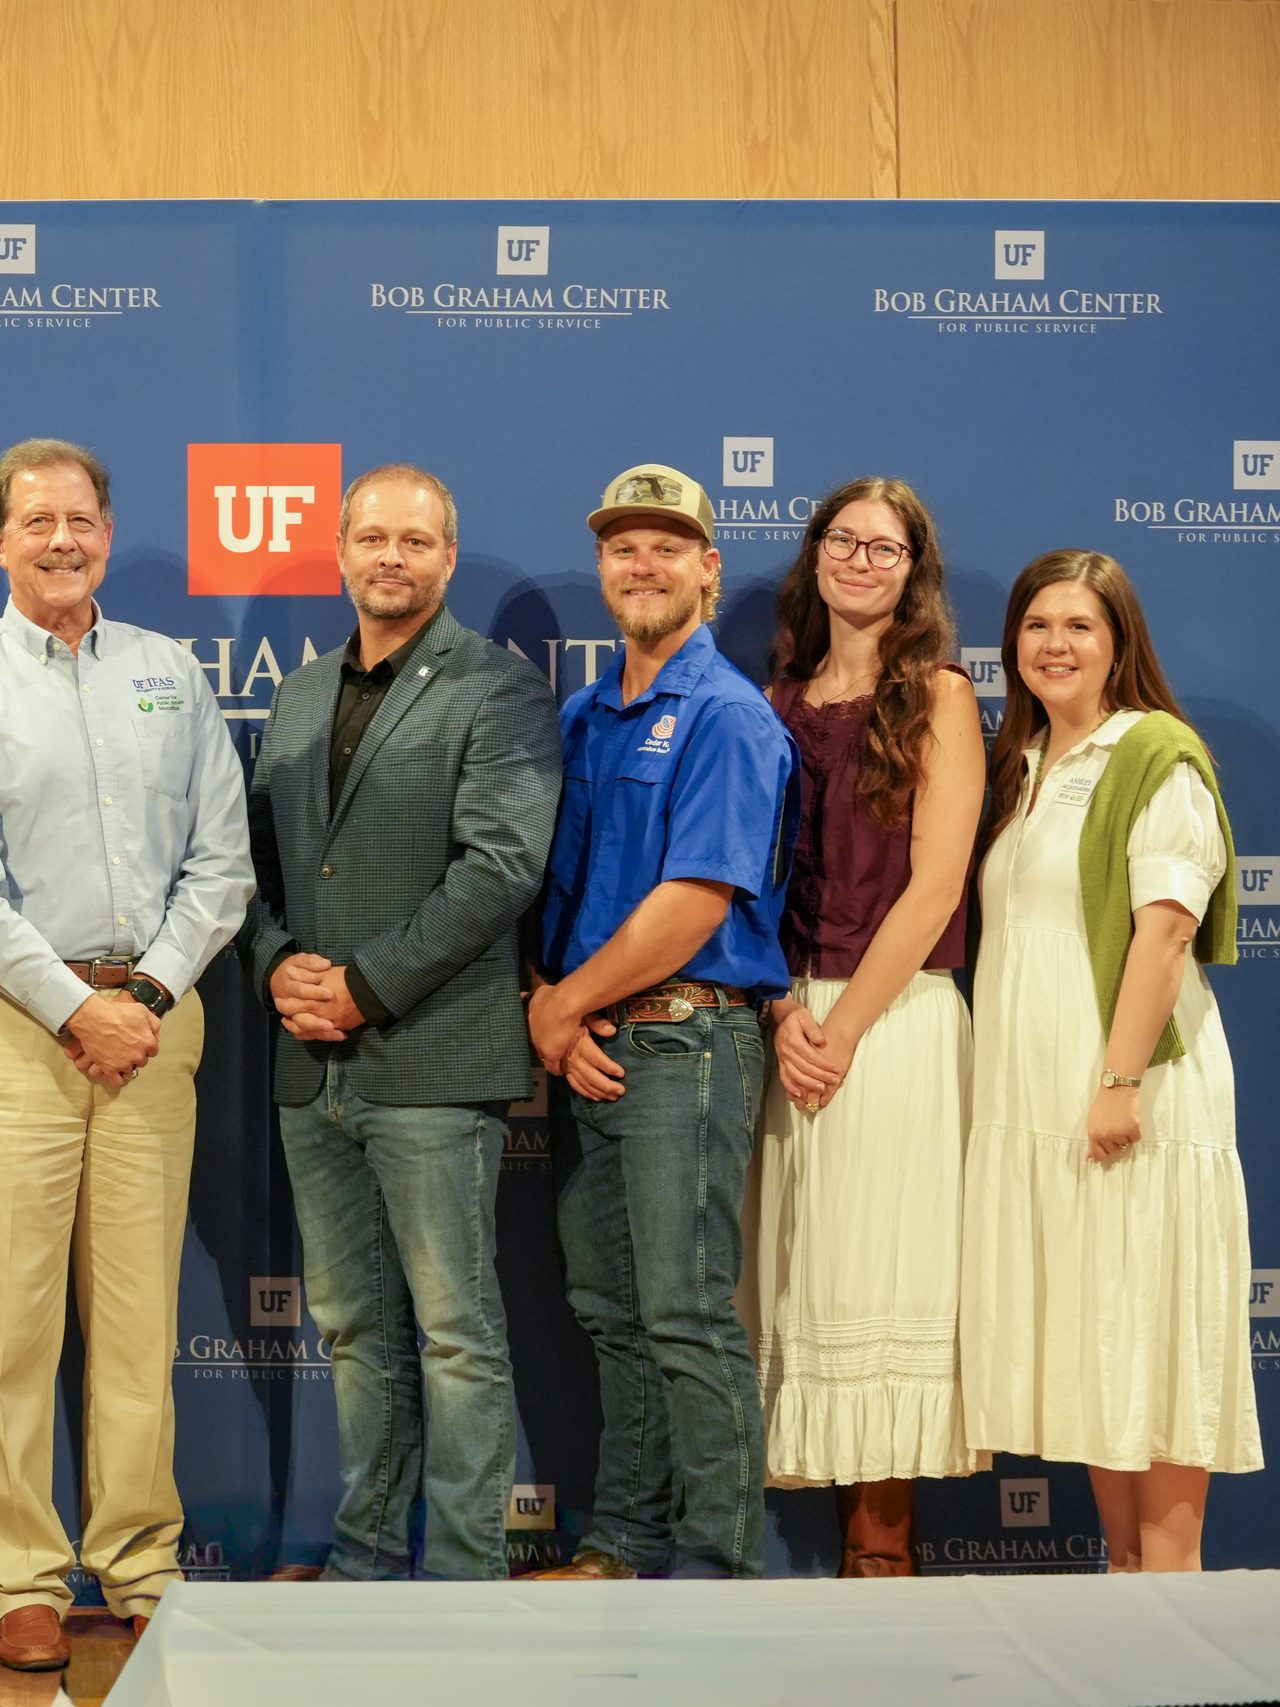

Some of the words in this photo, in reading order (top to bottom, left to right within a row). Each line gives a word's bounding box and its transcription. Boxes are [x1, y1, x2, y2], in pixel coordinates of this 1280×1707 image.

[507, 239, 540, 262] UF
[1003, 244, 1036, 266] UF
[51, 284, 161, 309] CENTER
[371, 283, 425, 308] BOB
[433, 283, 555, 309] GRAHAM
[562, 284, 670, 310] CENTER
[873, 288, 926, 313] BOB
[934, 288, 1051, 313] GRAHAM
[1059, 289, 1164, 314] CENTER
[27, 318, 92, 328] SERVICE
[438, 317, 468, 328] FOR
[475, 318, 532, 329] PUBLIC
[538, 318, 602, 329] SERVICE
[938, 322, 968, 333] FOR
[975, 322, 1029, 334] PUBLIC
[1035, 322, 1097, 334] SERVICE
[732, 451, 765, 473] UF
[1242, 454, 1274, 477] UF
[214, 485, 315, 553] UF
[1114, 498, 1166, 523] BOB
[713, 530, 757, 541] UBLIC
[1178, 532, 1207, 543] FOR
[1214, 533, 1267, 543] PUBLIC
[969, 661, 1001, 683] UF
[1241, 870, 1273, 892] UF
[258, 1290, 292, 1313] UF
[189, 1335, 311, 1360] GRAHAM
[194, 1369, 224, 1380] FOR
[231, 1369, 288, 1380] PUBLIC
[293, 1369, 330, 1380] SERV
[1009, 1492, 1041, 1513] UF
[943, 1536, 1059, 1563] GRAHAM
